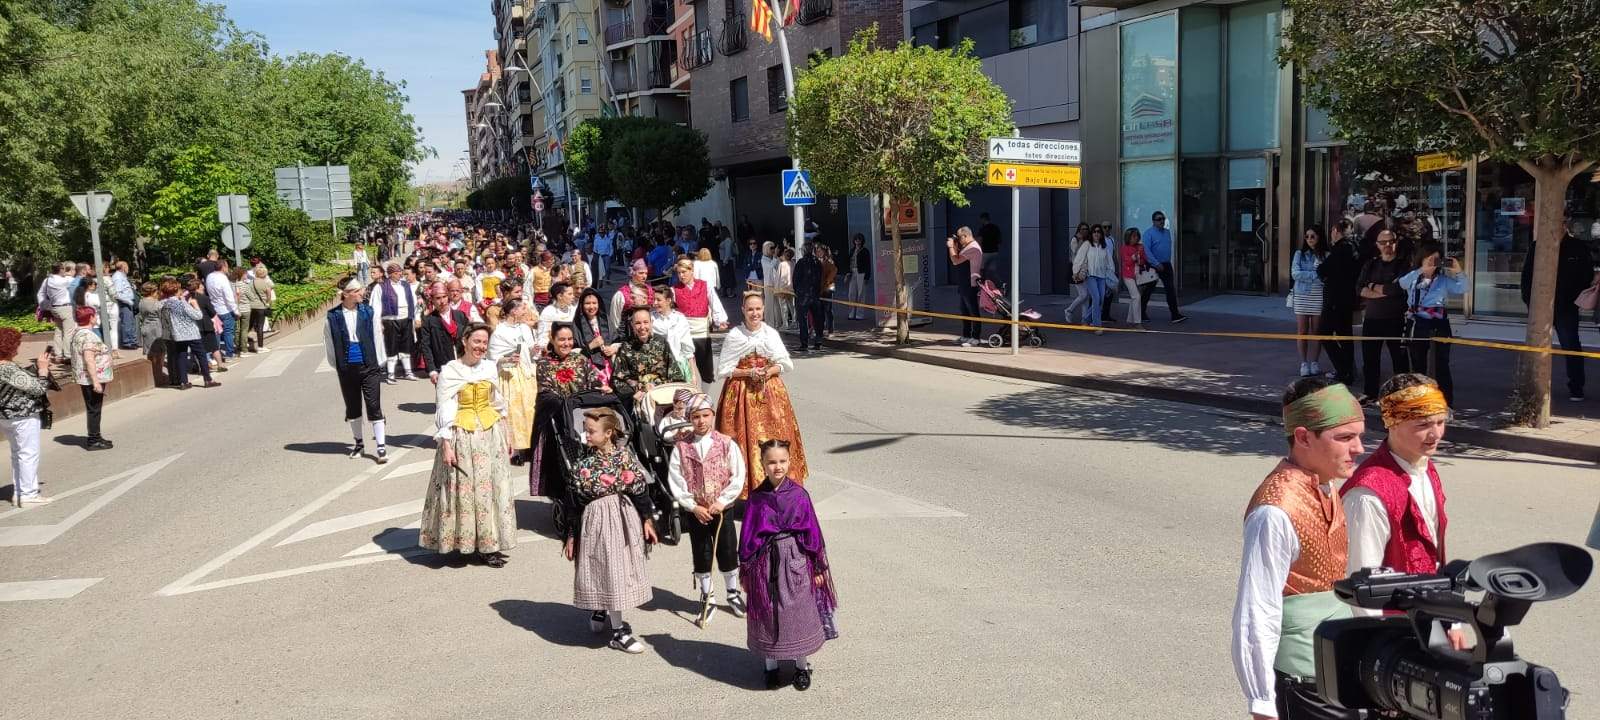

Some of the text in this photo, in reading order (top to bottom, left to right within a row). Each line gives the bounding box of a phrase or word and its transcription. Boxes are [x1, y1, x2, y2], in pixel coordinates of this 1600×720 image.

[1008, 141, 1078, 151] todas direcciones
[1445, 680, 1462, 692] SONY
